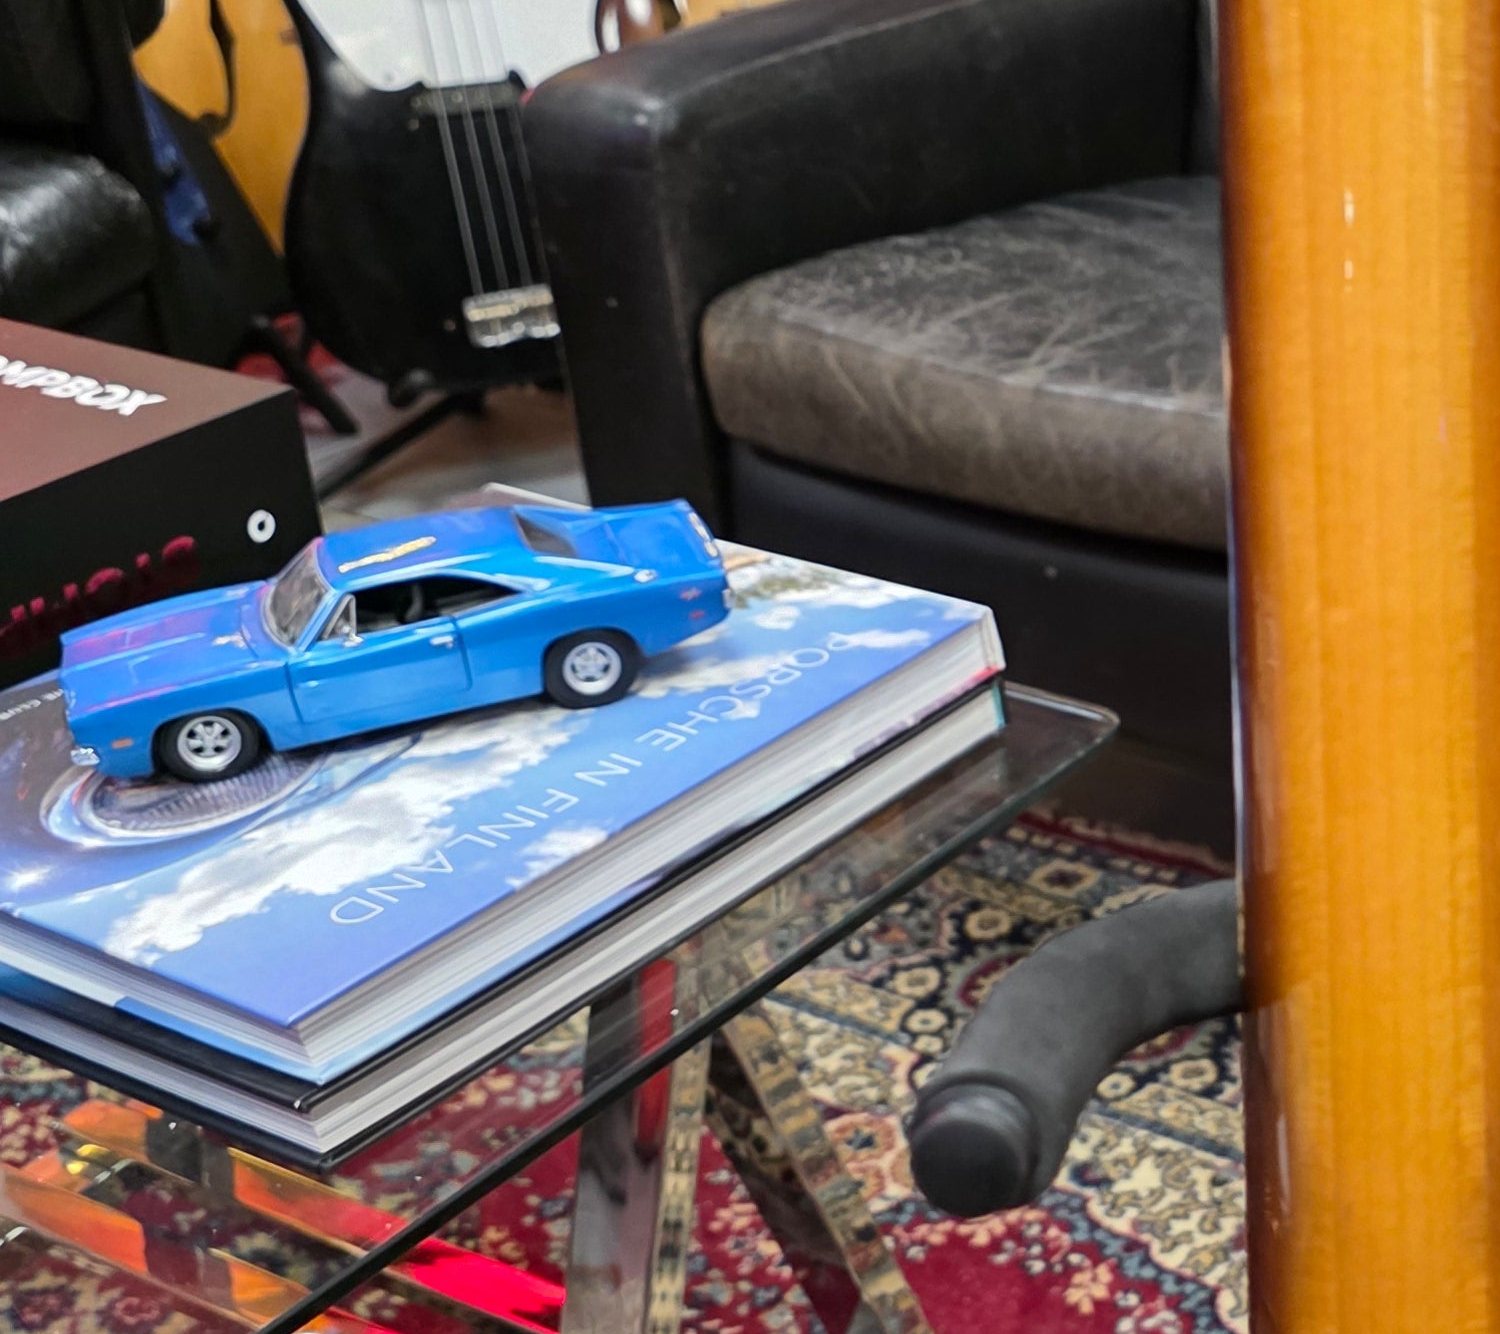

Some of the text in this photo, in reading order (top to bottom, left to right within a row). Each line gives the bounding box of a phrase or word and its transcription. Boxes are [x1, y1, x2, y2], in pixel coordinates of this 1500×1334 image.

[330, 631, 858, 924] PORSCHE IN FINLAND
